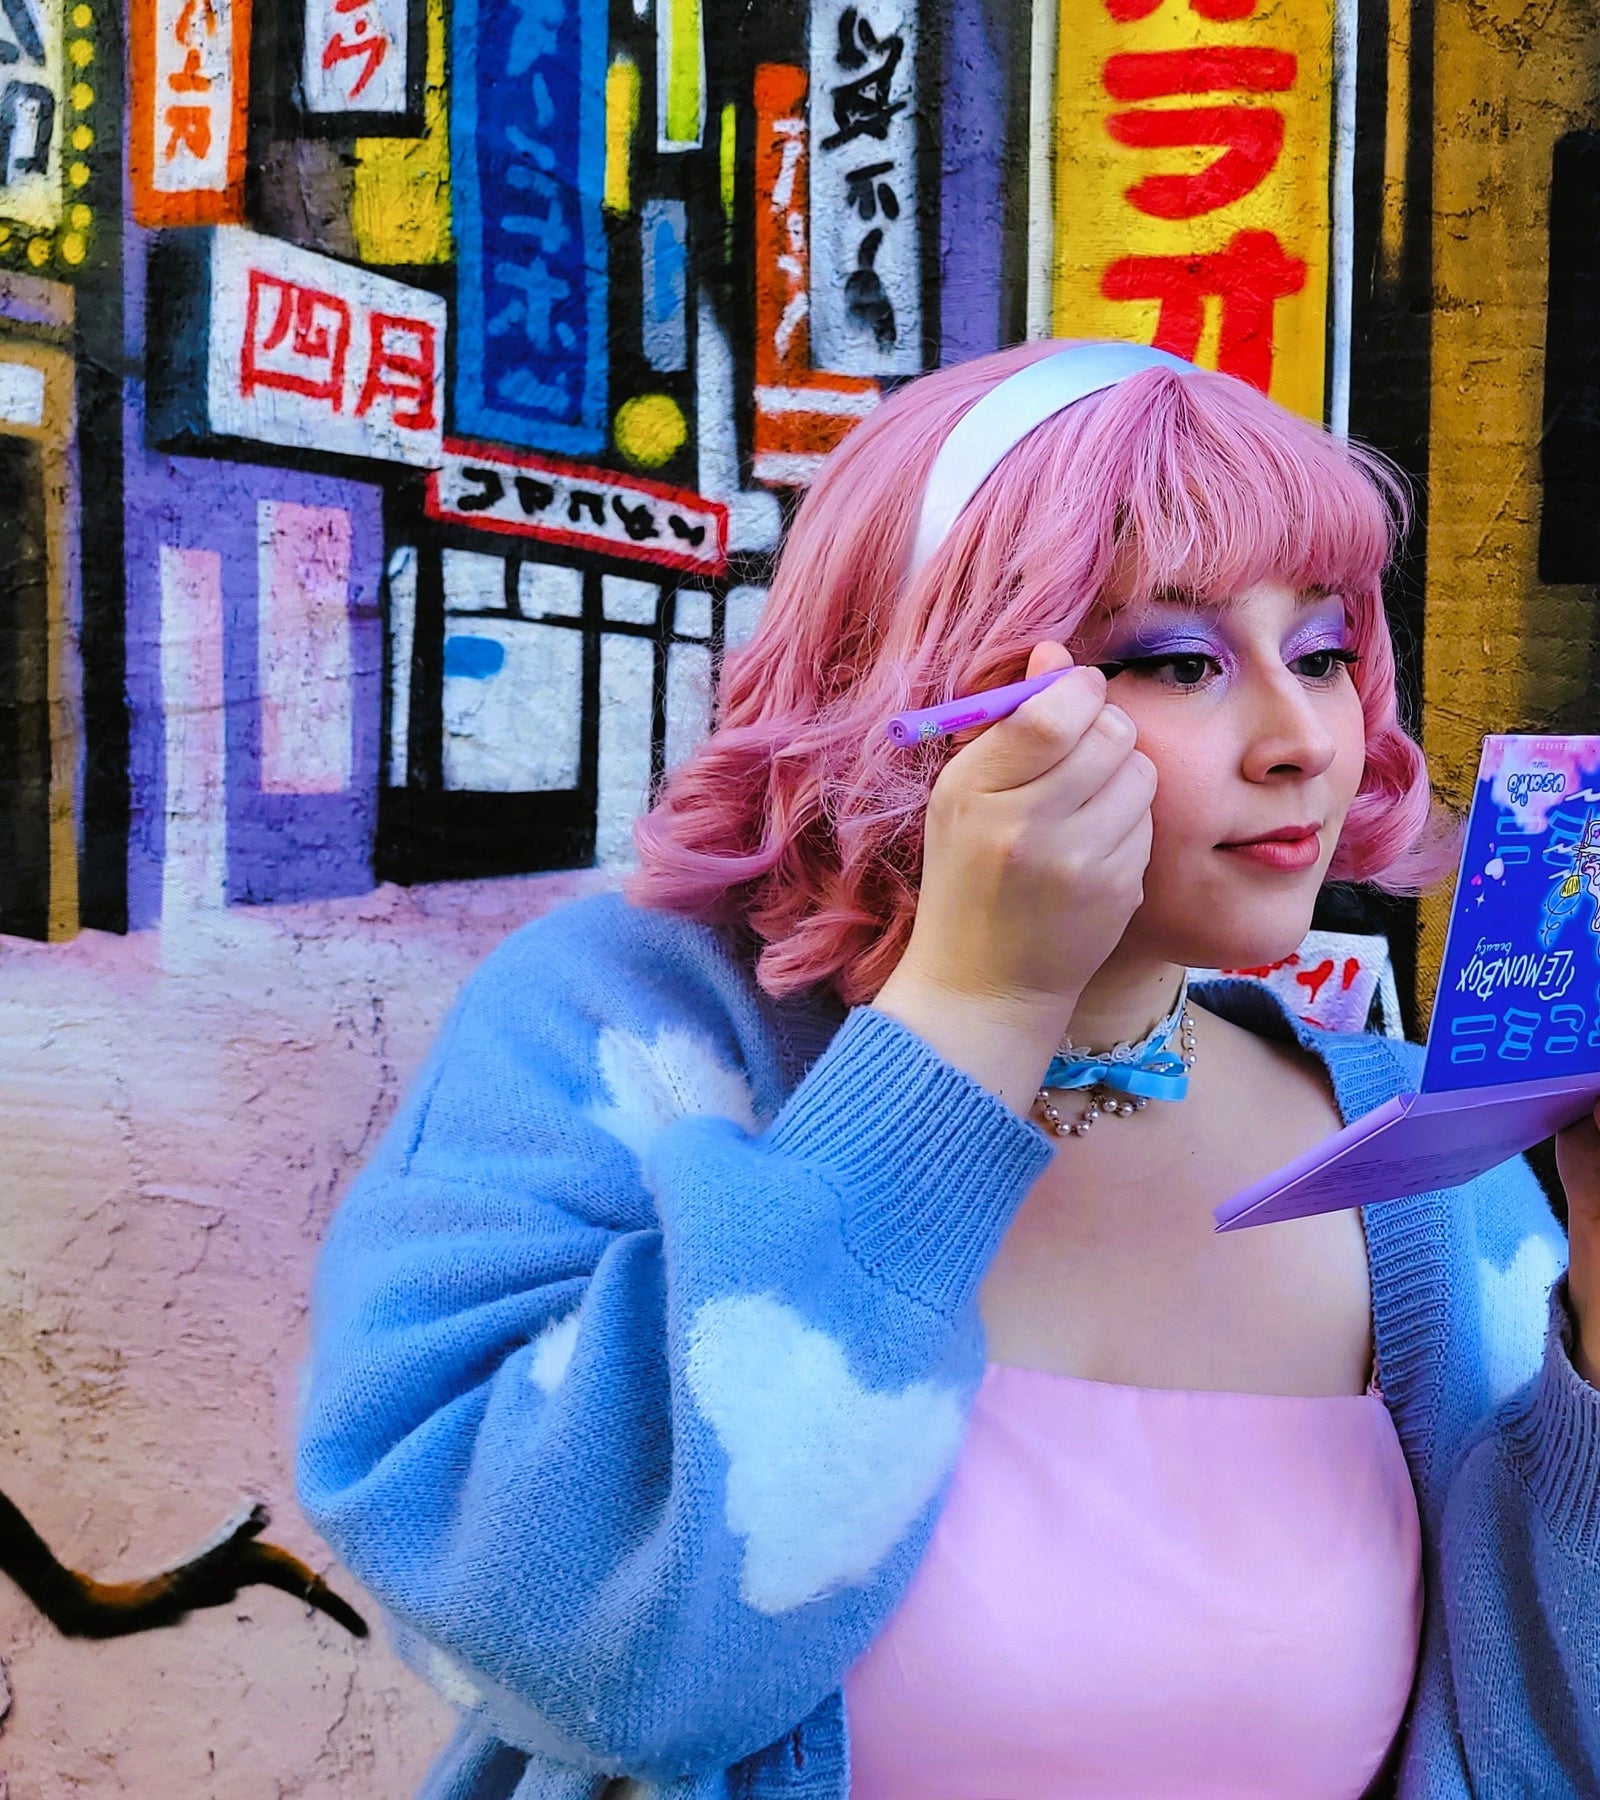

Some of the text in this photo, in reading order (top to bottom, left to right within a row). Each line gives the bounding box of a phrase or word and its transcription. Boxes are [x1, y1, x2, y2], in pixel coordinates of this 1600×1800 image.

[1101, 0, 1308, 398] ラオ
[240, 267, 438, 430] 四月
[1475, 936, 1512, 956] beauty
